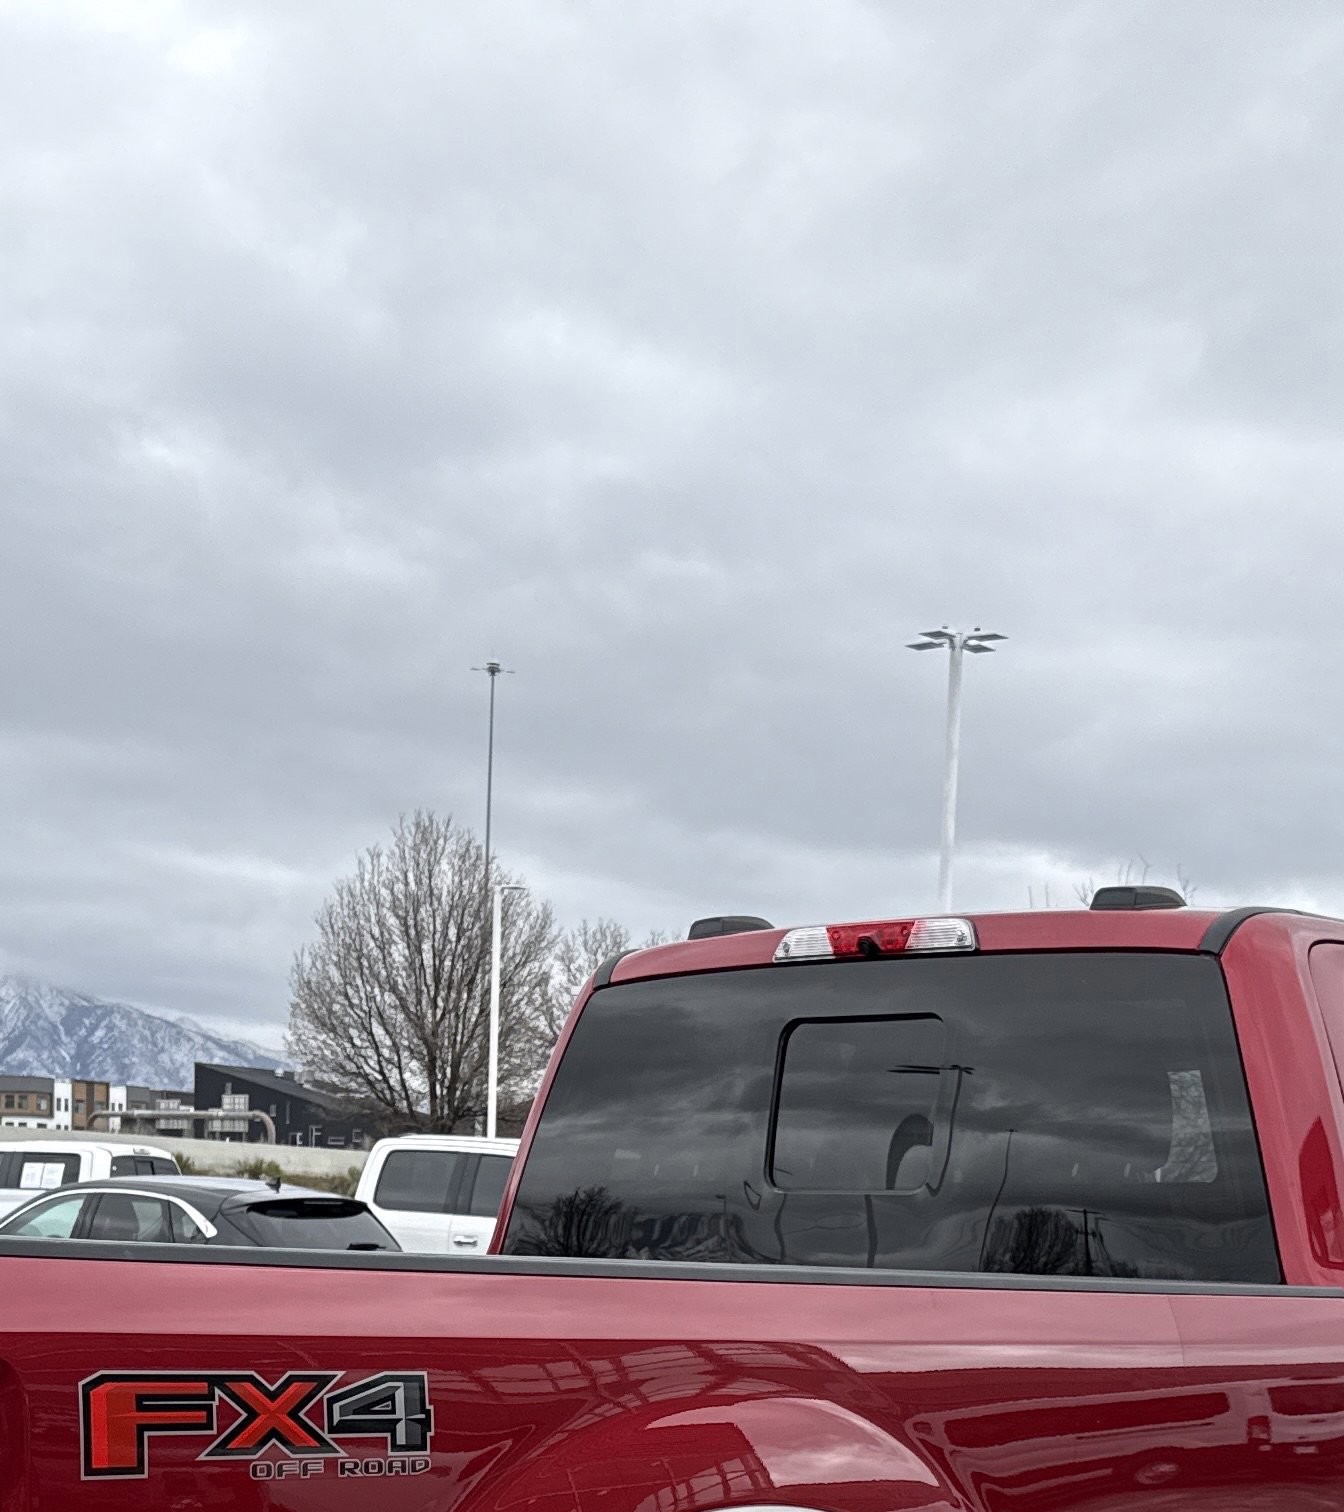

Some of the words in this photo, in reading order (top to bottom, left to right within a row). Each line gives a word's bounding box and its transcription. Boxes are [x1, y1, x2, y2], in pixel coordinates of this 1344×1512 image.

[77, 1369, 435, 1481] FX4
[249, 1460, 325, 1481] OFF
[338, 1457, 432, 1479] ROAD
